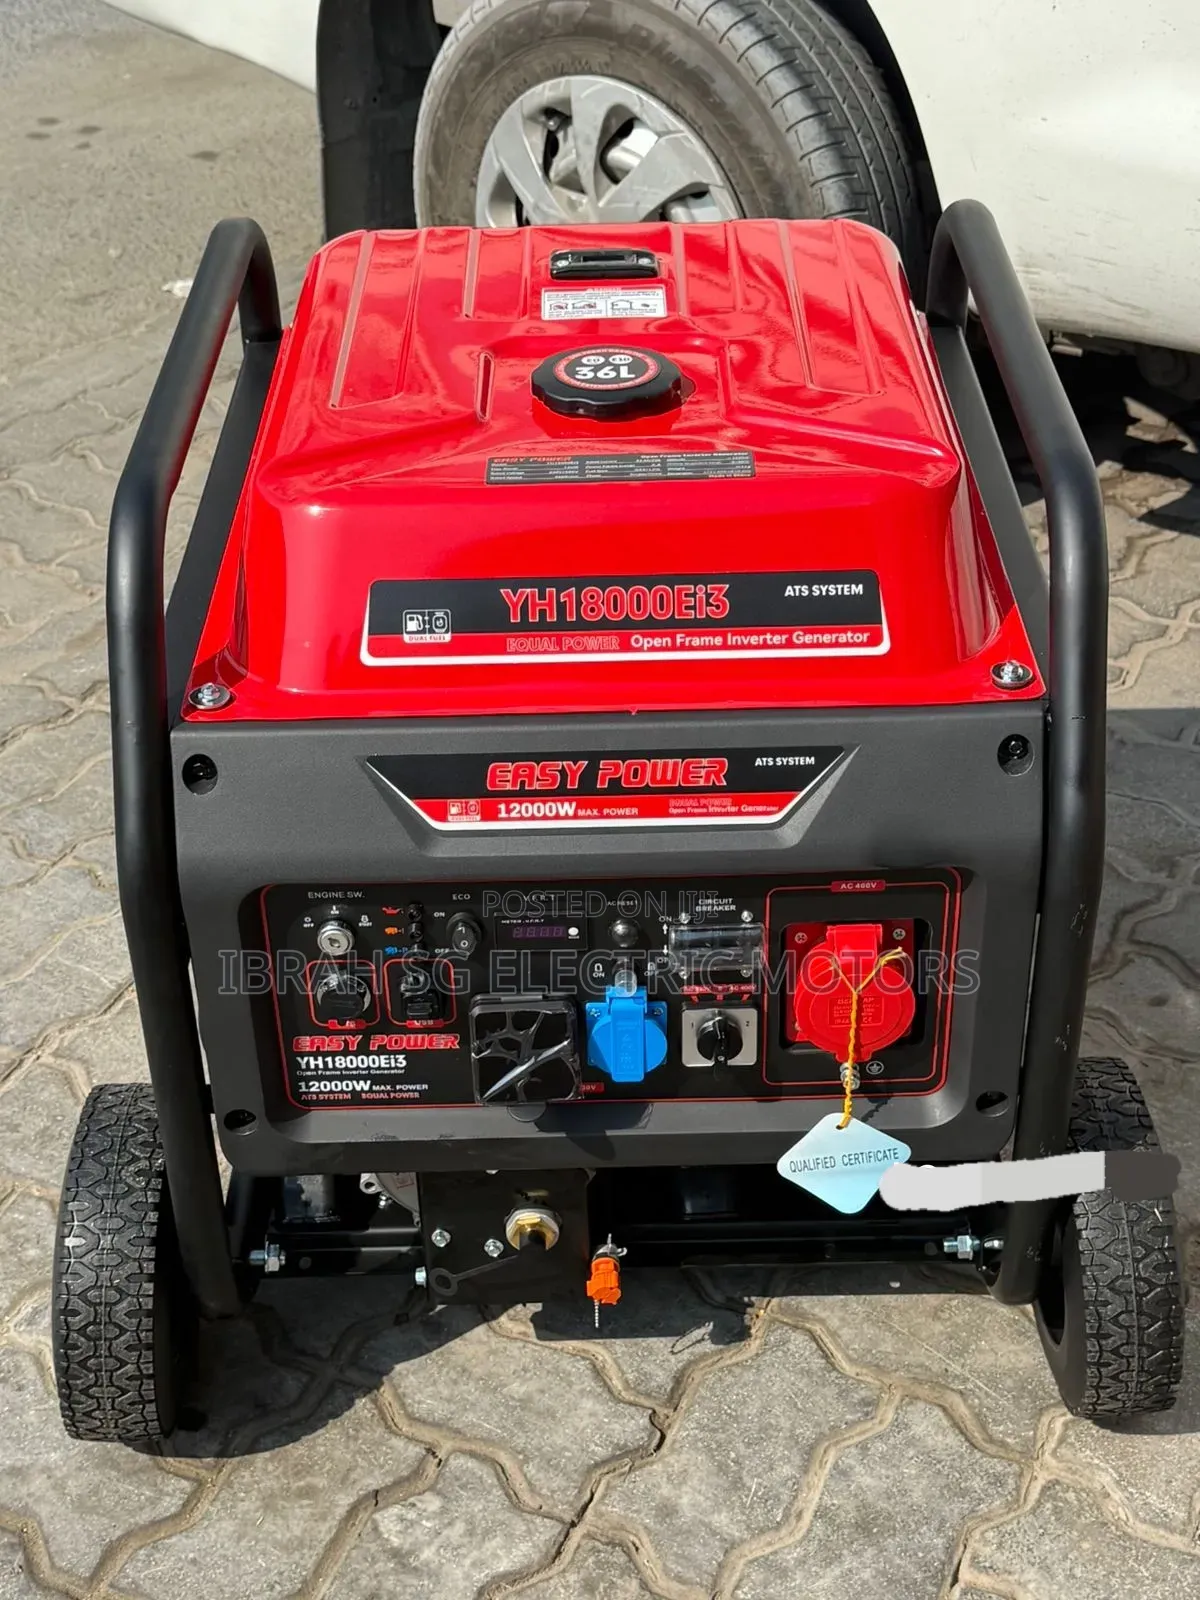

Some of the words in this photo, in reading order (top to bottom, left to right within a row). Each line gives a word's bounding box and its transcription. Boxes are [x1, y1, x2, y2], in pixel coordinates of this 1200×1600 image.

[575, 365, 636, 380] 36L
[784, 585, 808, 597] ATS
[812, 583, 864, 597] SYSTEM
[499, 583, 731, 623] YH18000Ei3
[506, 637, 558, 652] EQUAL
[562, 635, 620, 651] POWER
[630, 632, 672, 650] Open
[675, 631, 723, 647] Frame
[727, 629, 787, 646] Inverter
[792, 628, 871, 645] Generator
[755, 757, 773, 767] ATS
[775, 755, 816, 766] SYSTEM
[486, 760, 588, 791] EASY
[597, 757, 729, 788] POWER
[497, 801, 576, 818] 12000W
[603, 807, 639, 816] POWER
[841, 882, 853, 890] AC
[855, 881, 877, 889] 400V
[307, 891, 345, 899] ENGINE
[347, 890, 365, 898] SW.
[292, 1036, 363, 1051] EASY
[369, 1034, 461, 1050] POWER
[296, 1055, 407, 1069] YH18000Ei3
[298, 1080, 371, 1092] 12000W
[789, 1156, 836, 1173] QUALIFIED
[842, 1148, 900, 1167] CERTIFICATE
